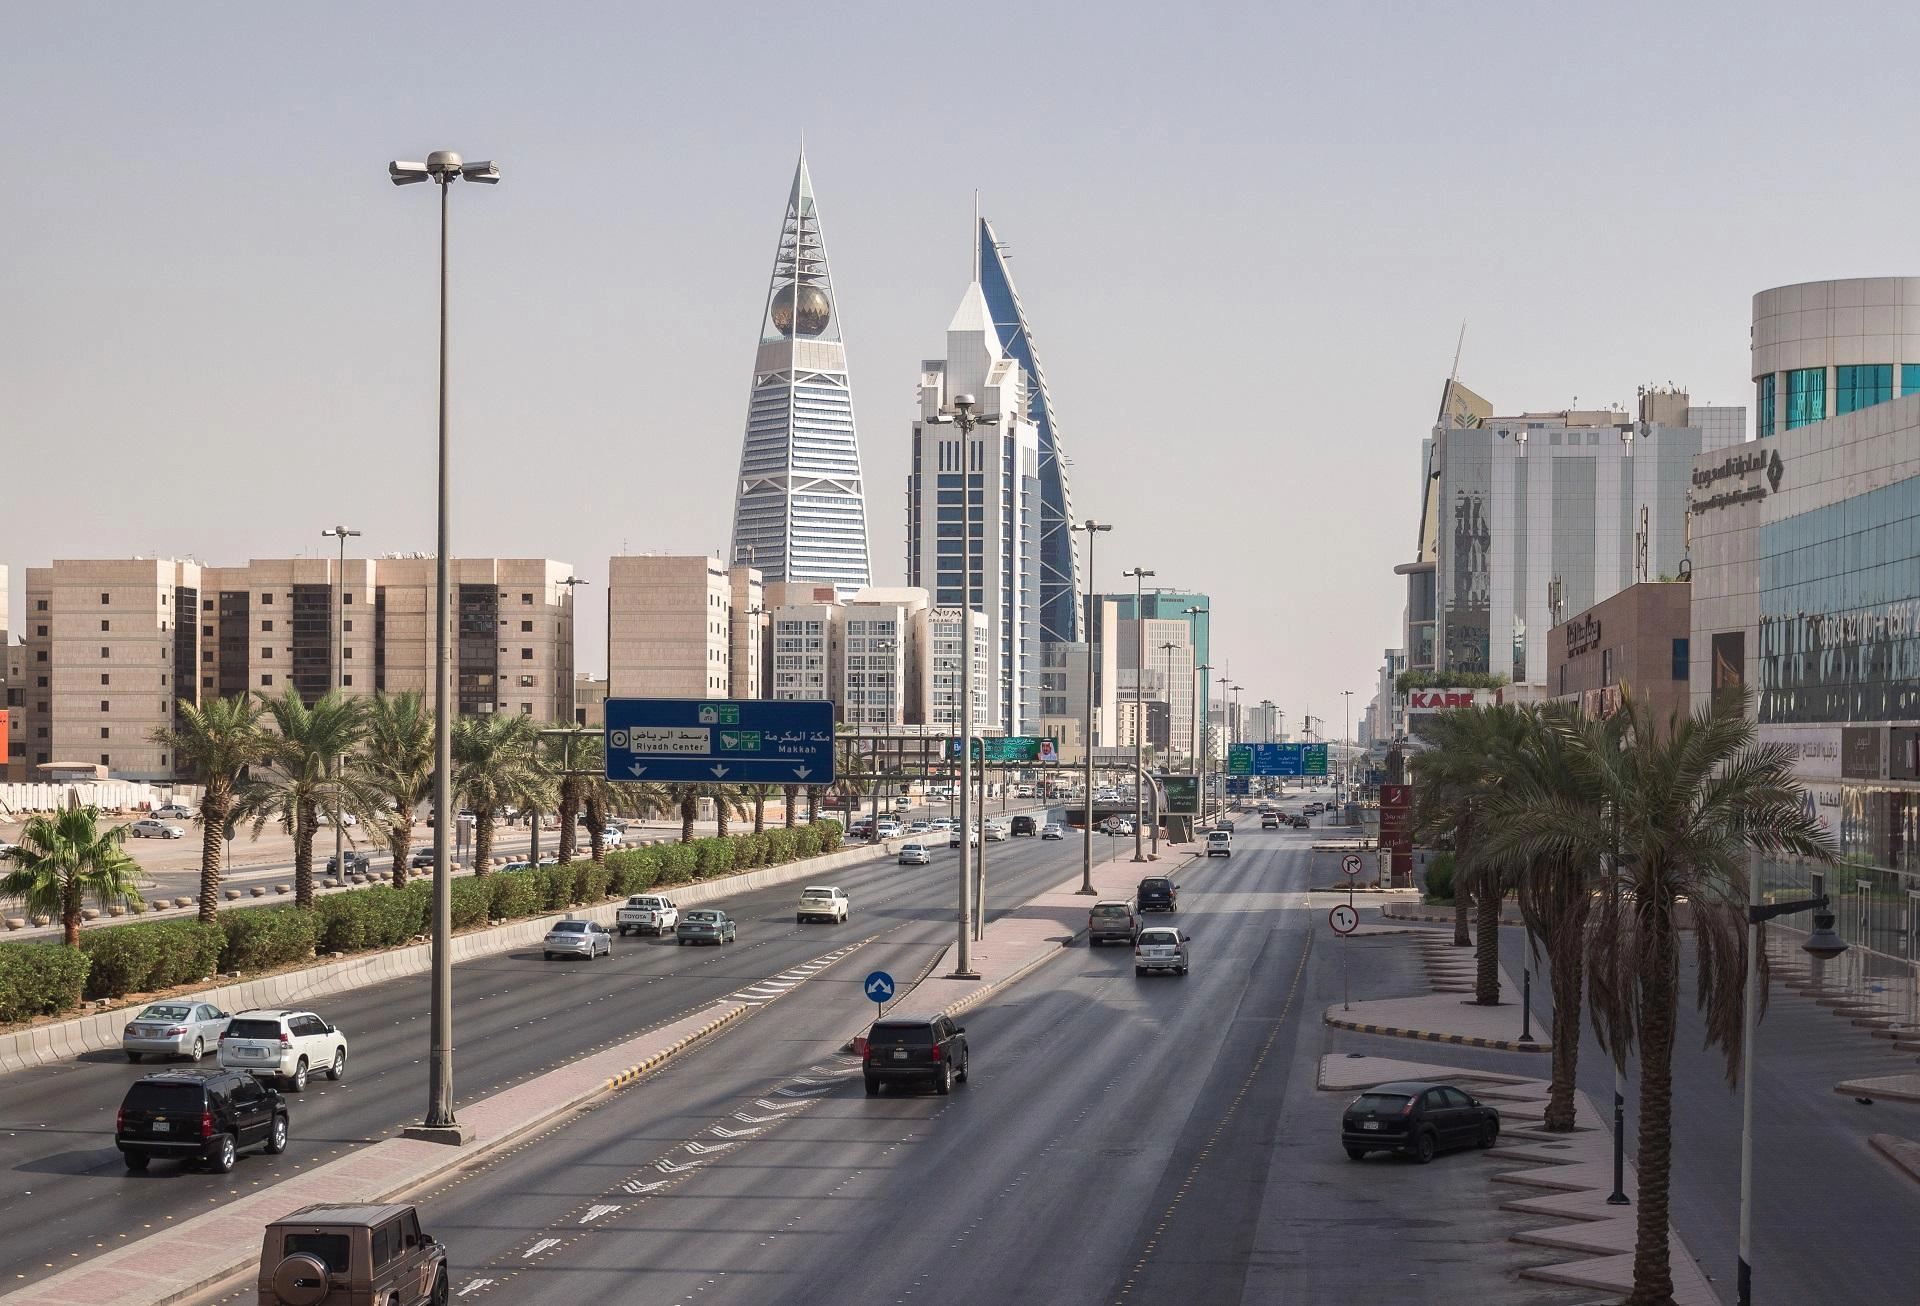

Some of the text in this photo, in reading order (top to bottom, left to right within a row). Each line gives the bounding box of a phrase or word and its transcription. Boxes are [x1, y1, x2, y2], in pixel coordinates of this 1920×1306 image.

[632, 730, 708, 741] وسط الرياض
[765, 731, 830, 743] مكة المكرمة
[636, 743, 669, 751] Riyadh
[778, 745, 816, 753] Makkah
[1336, 912, 1352, 926] ٦٠
